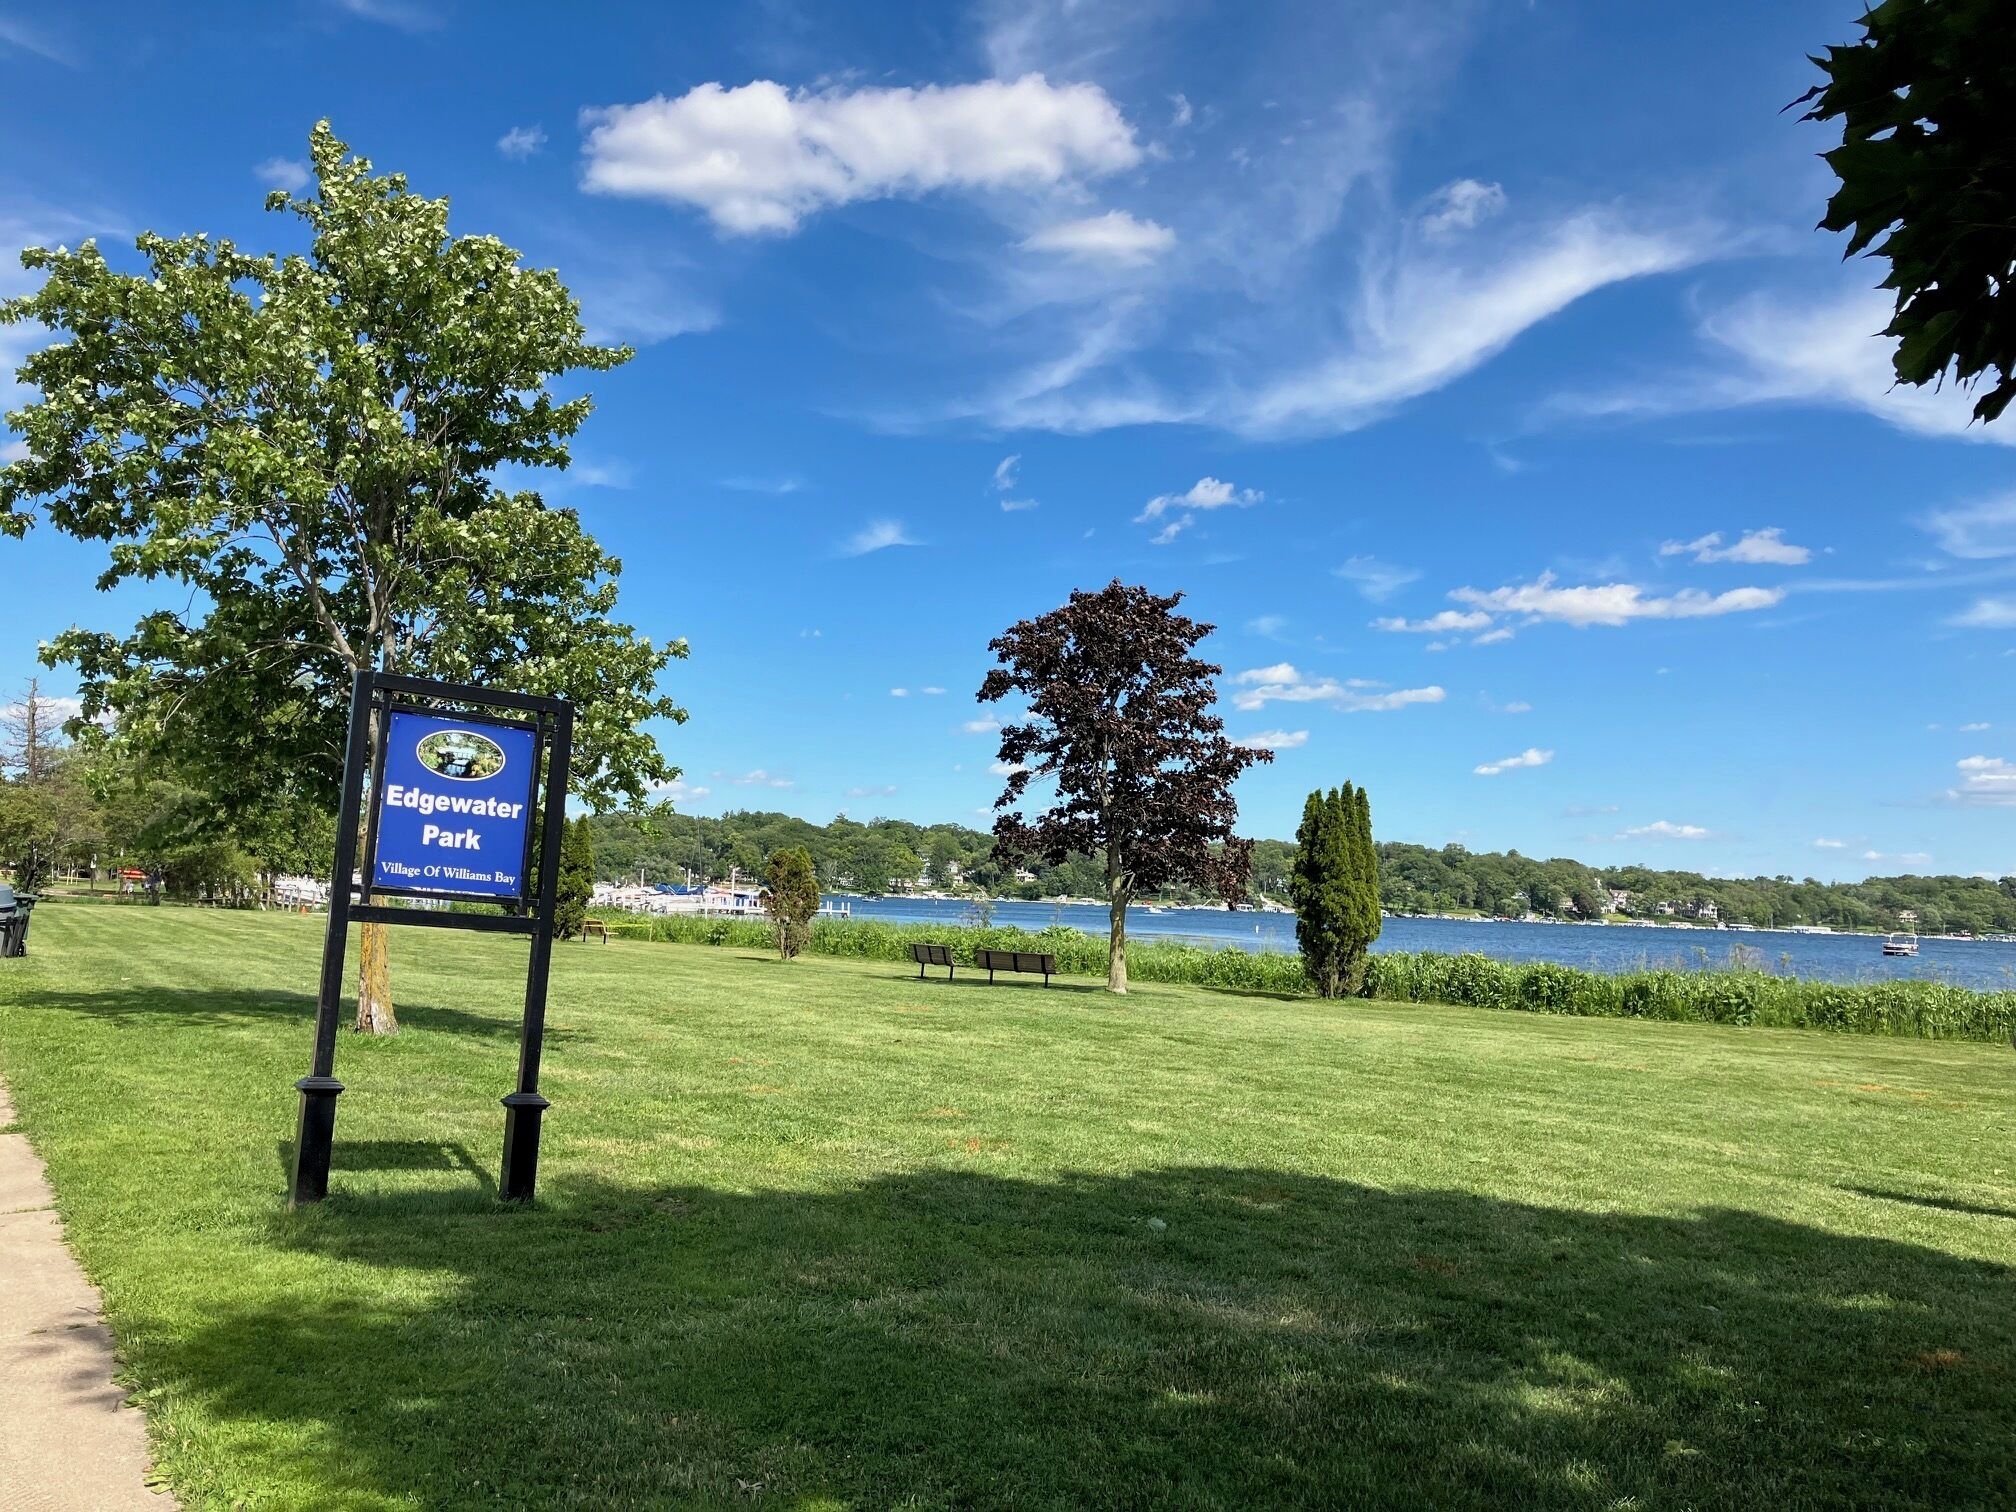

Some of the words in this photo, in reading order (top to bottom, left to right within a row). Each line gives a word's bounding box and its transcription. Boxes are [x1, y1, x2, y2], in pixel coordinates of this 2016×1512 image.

[387, 785, 523, 818] Edgewater
[422, 825, 481, 850] Park
[382, 862, 421, 877] Village
[424, 865, 441, 877] Of
[443, 867, 491, 881] Williams
[495, 872, 515, 885] Bay
